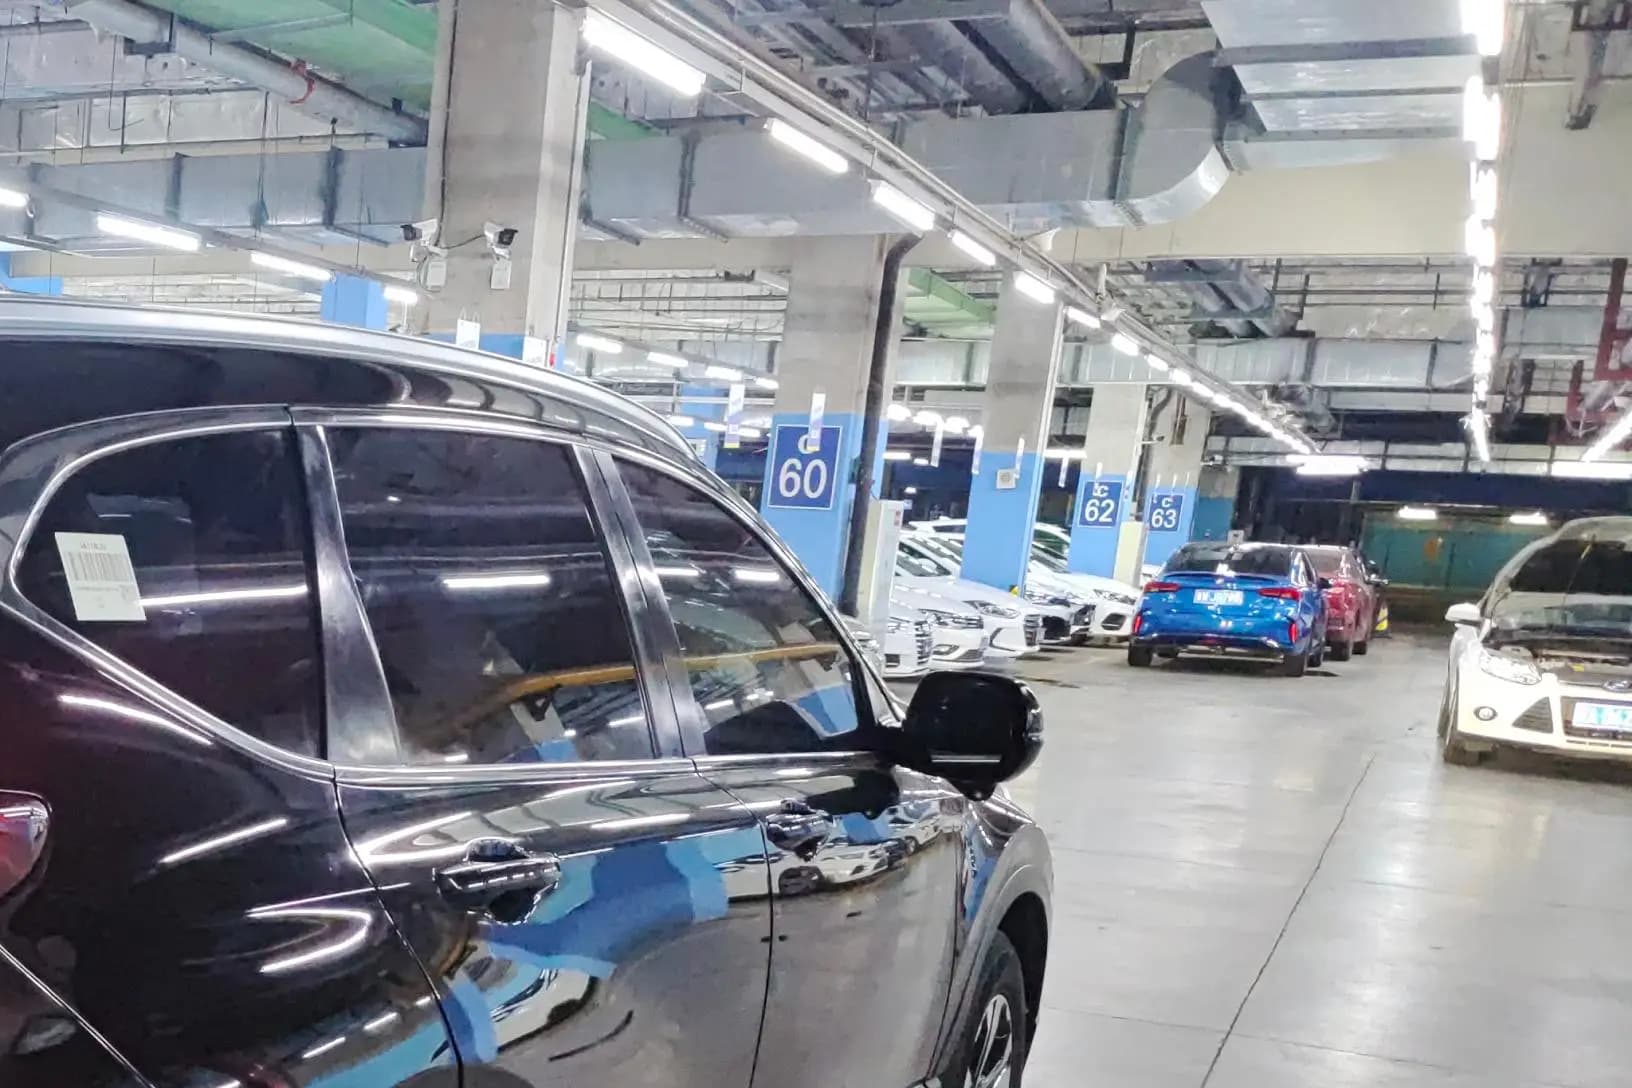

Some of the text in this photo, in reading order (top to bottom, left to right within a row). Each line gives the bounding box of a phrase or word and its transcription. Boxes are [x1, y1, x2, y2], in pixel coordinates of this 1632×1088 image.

[779, 458, 827, 499] 60
[1085, 499, 1115, 522] 62
[1152, 508, 1177, 528] 63
